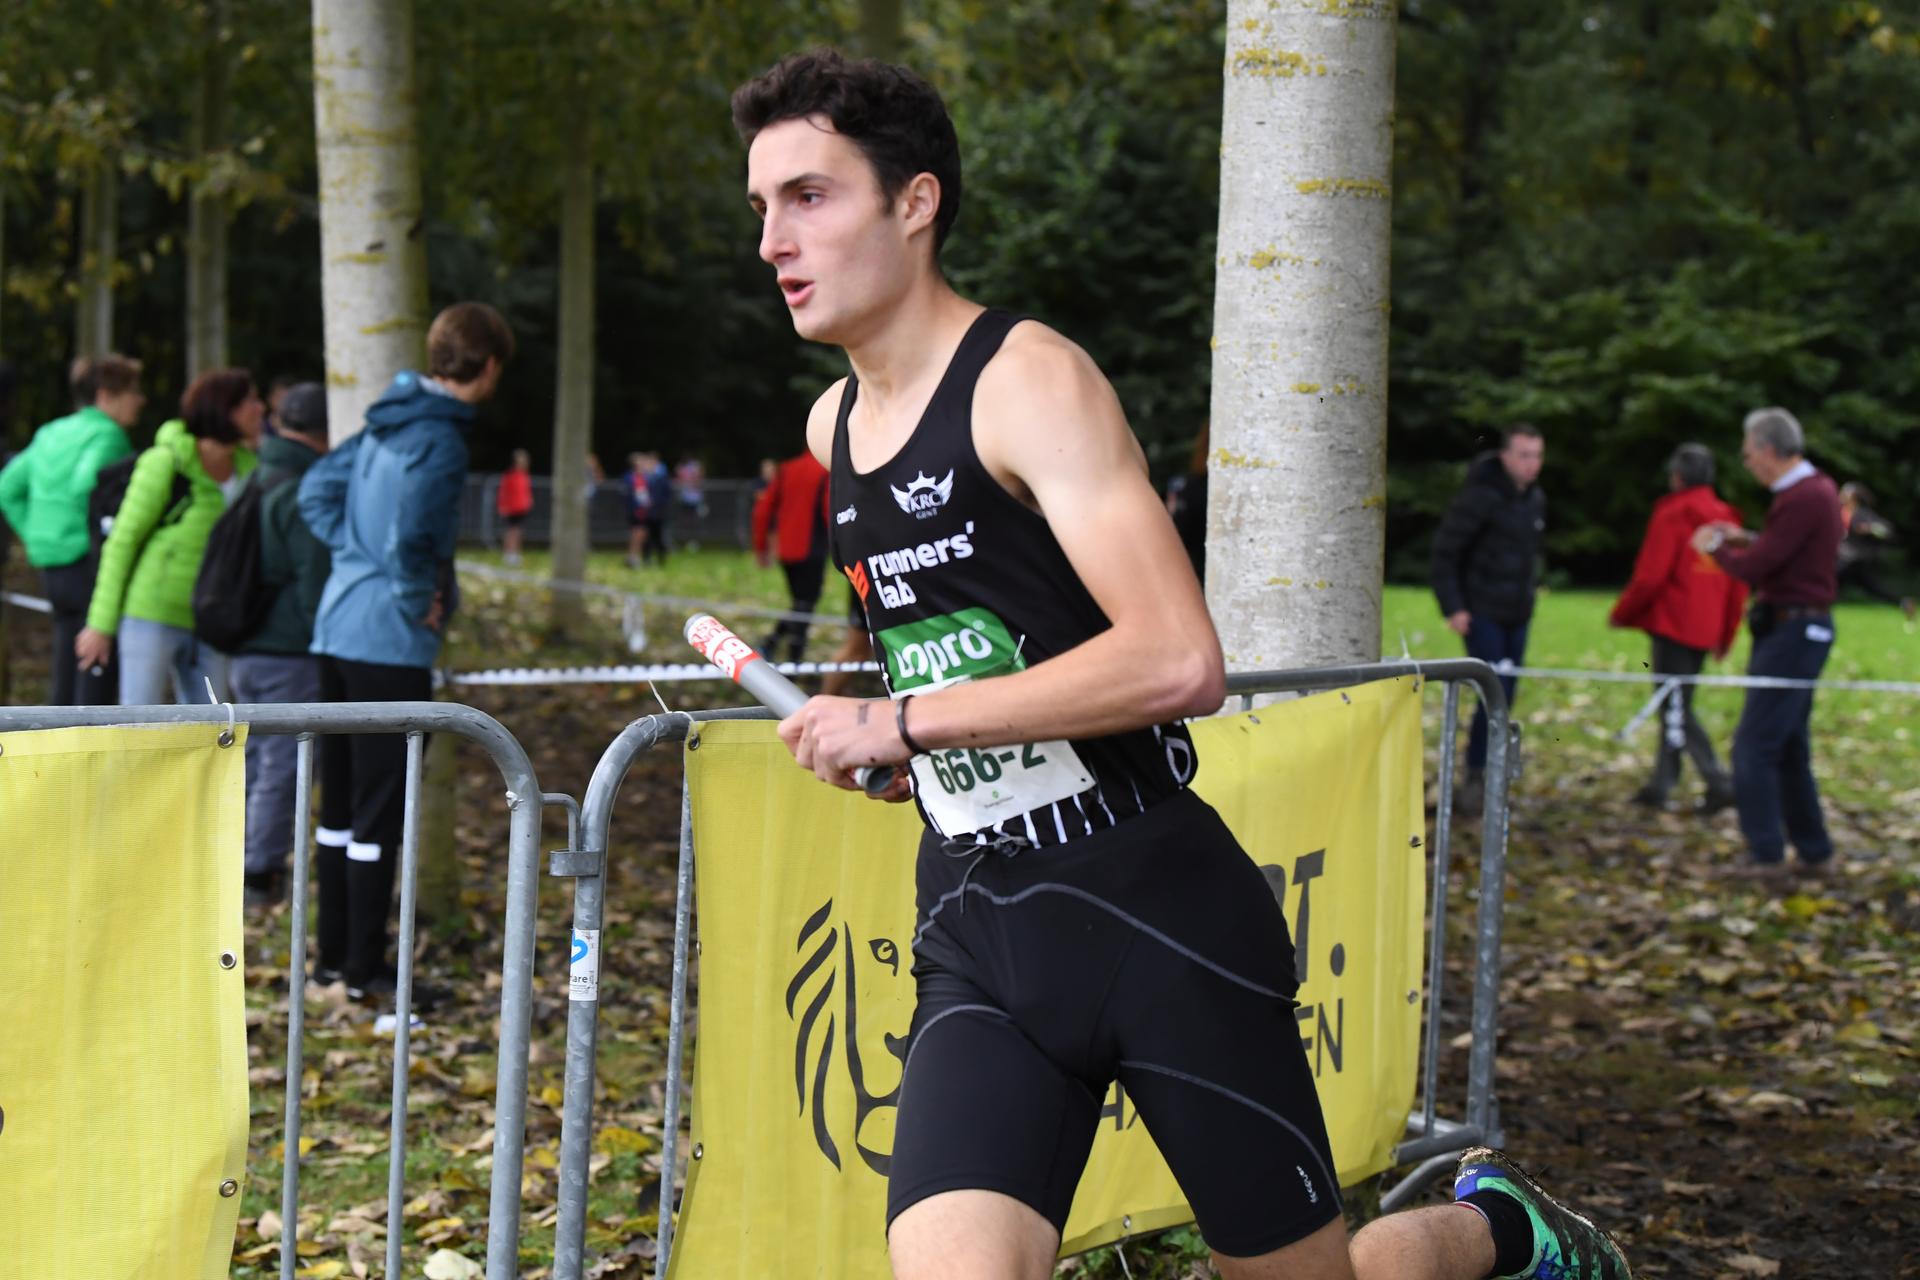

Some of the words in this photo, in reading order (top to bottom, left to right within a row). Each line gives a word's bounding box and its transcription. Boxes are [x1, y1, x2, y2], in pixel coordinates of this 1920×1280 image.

[867, 520, 974, 580] runners'
[874, 574, 918, 610] lab
[930, 742, 1047, 795] 666-2
[1259, 848, 1345, 984] T.
